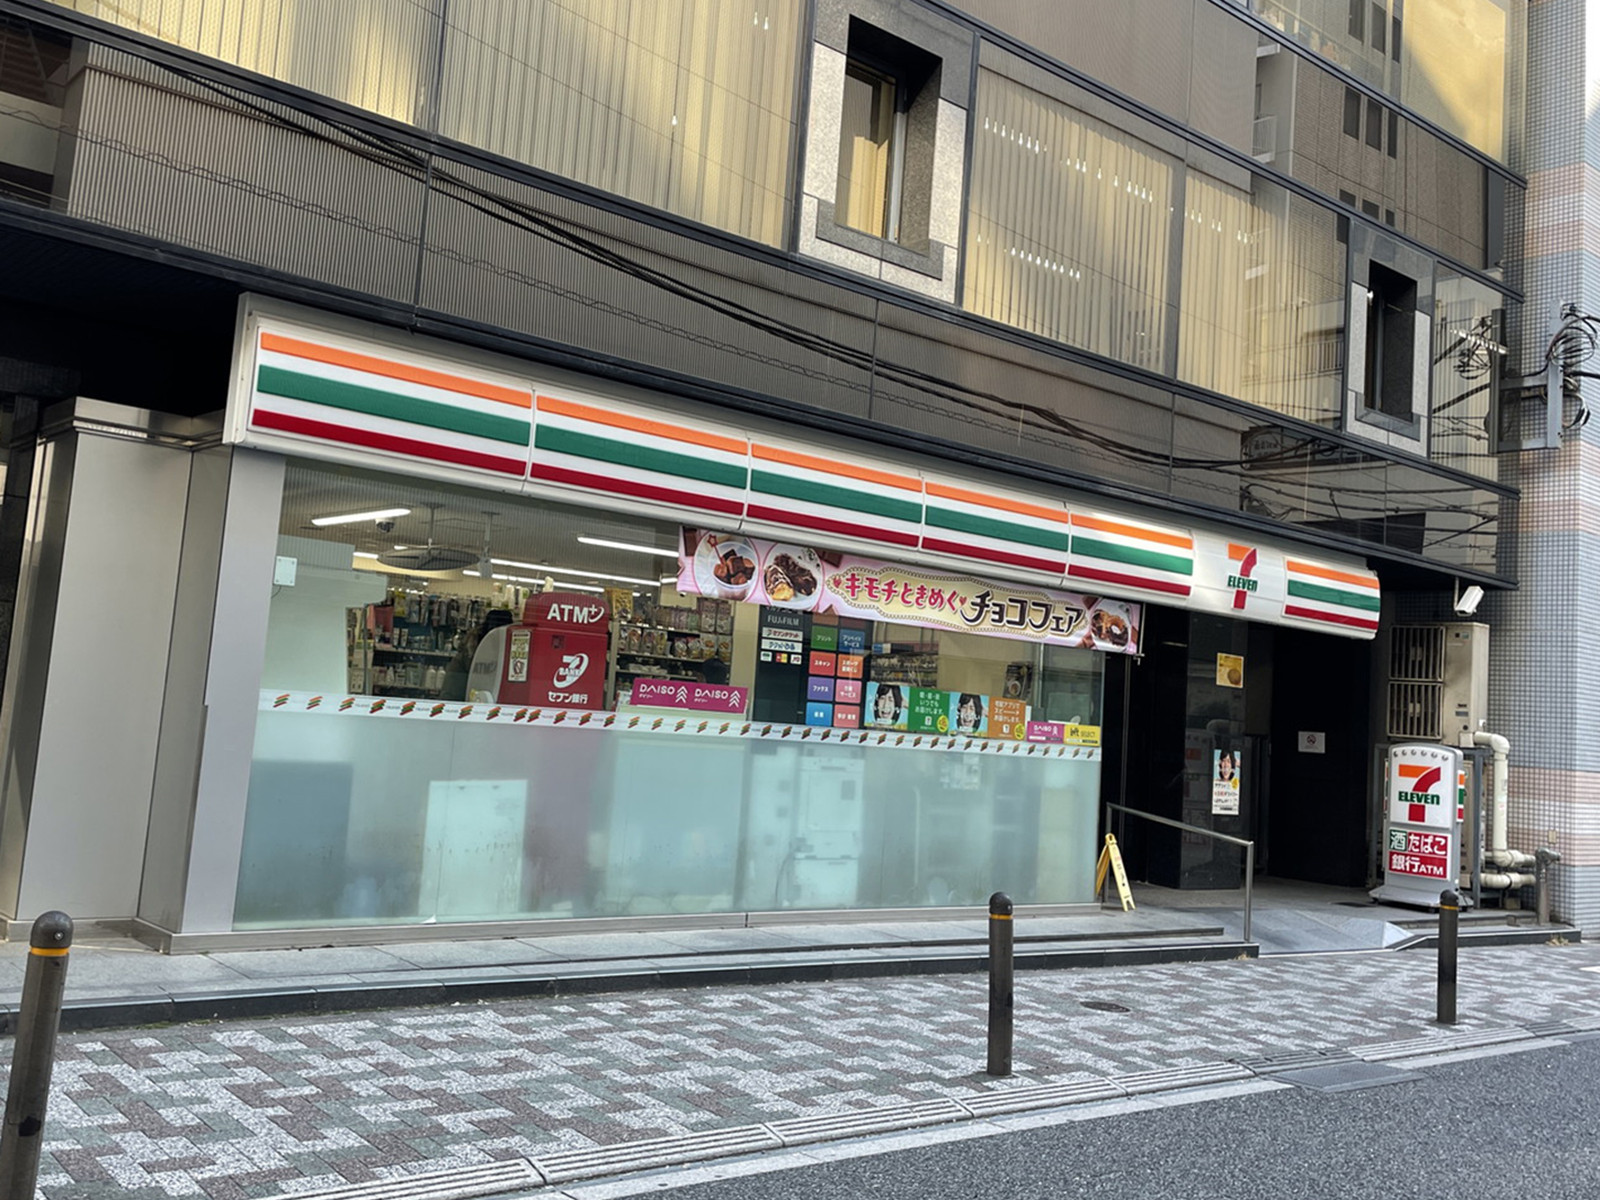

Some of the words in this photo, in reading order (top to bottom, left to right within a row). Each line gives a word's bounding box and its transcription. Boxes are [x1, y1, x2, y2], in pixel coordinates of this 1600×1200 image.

[845, 573, 958, 611] キモチときめく
[960, 590, 1084, 633] チョコフェア
[548, 691, 588, 704] セブン銀行
[639, 684, 675, 695] DAISO
[694, 688, 729, 699] DAISO
[1390, 831, 1406, 851] 酒
[1408, 833, 1446, 855] たばこ
[1391, 854, 1444, 875] 銀行ATM
